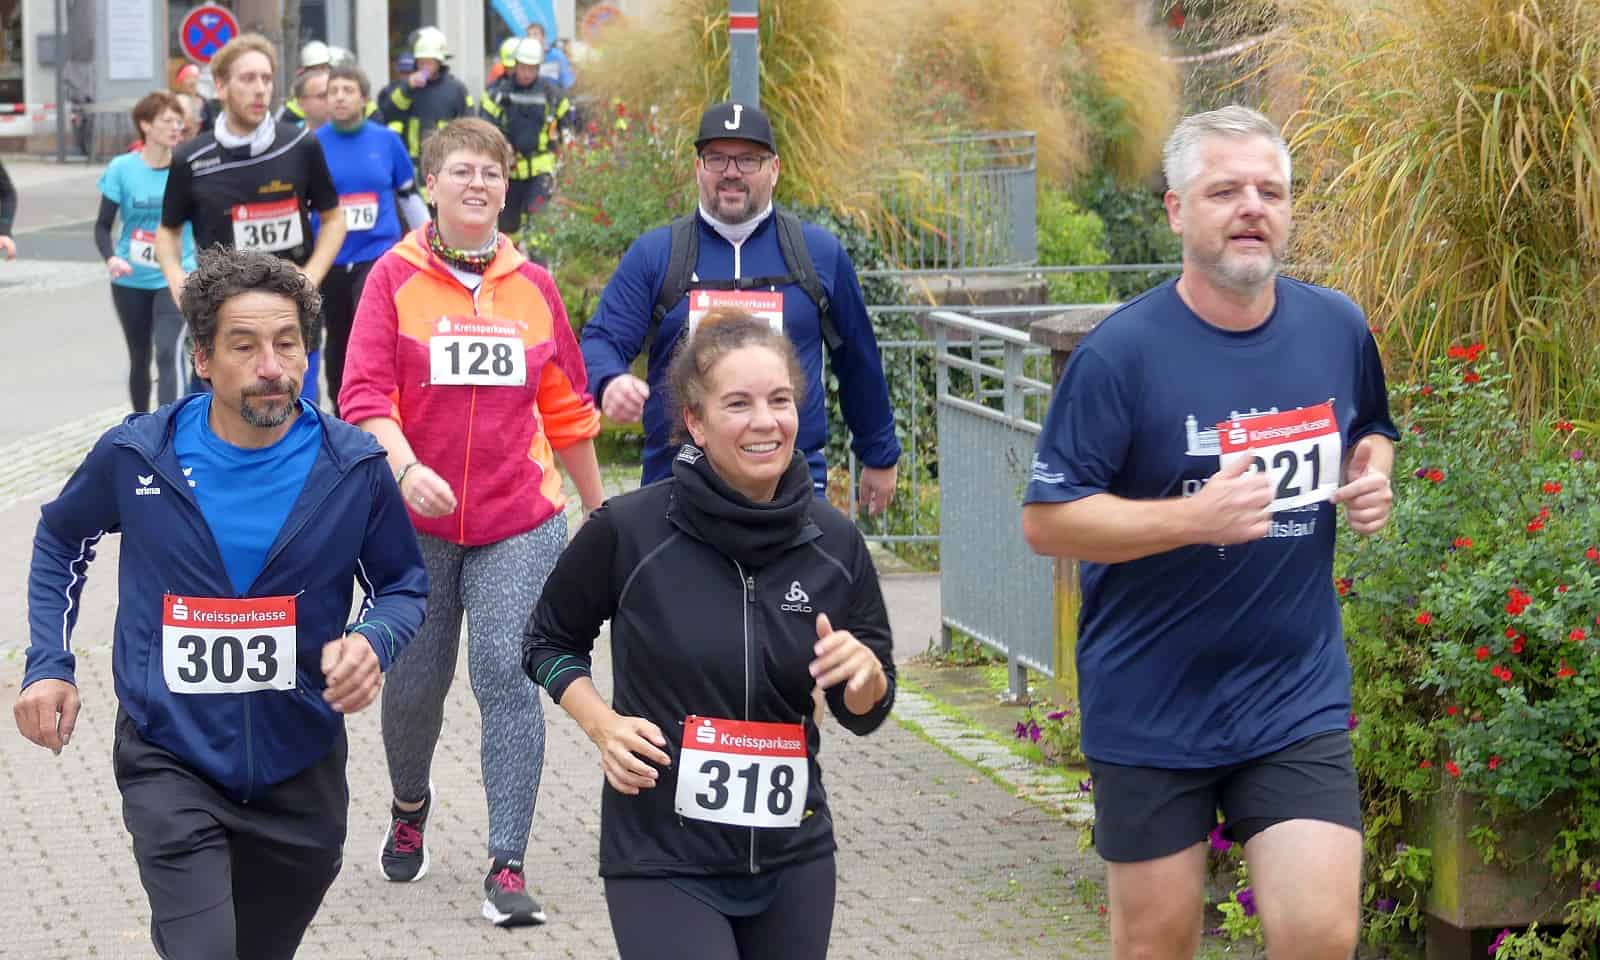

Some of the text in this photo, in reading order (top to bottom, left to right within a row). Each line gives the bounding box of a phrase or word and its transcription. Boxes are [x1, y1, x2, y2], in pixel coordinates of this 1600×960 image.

[724, 104, 743, 130] J
[344, 207, 374, 225] 76
[244, 220, 292, 247] 367
[444, 340, 514, 377] 128
[1250, 418, 1331, 441] Kreissparkasse
[1249, 443, 1320, 500] 21
[192, 609, 287, 625] Kreissparkasse
[177, 634, 279, 684] 303
[720, 732, 802, 751] Kreissparkasse
[695, 759, 795, 816] 318
